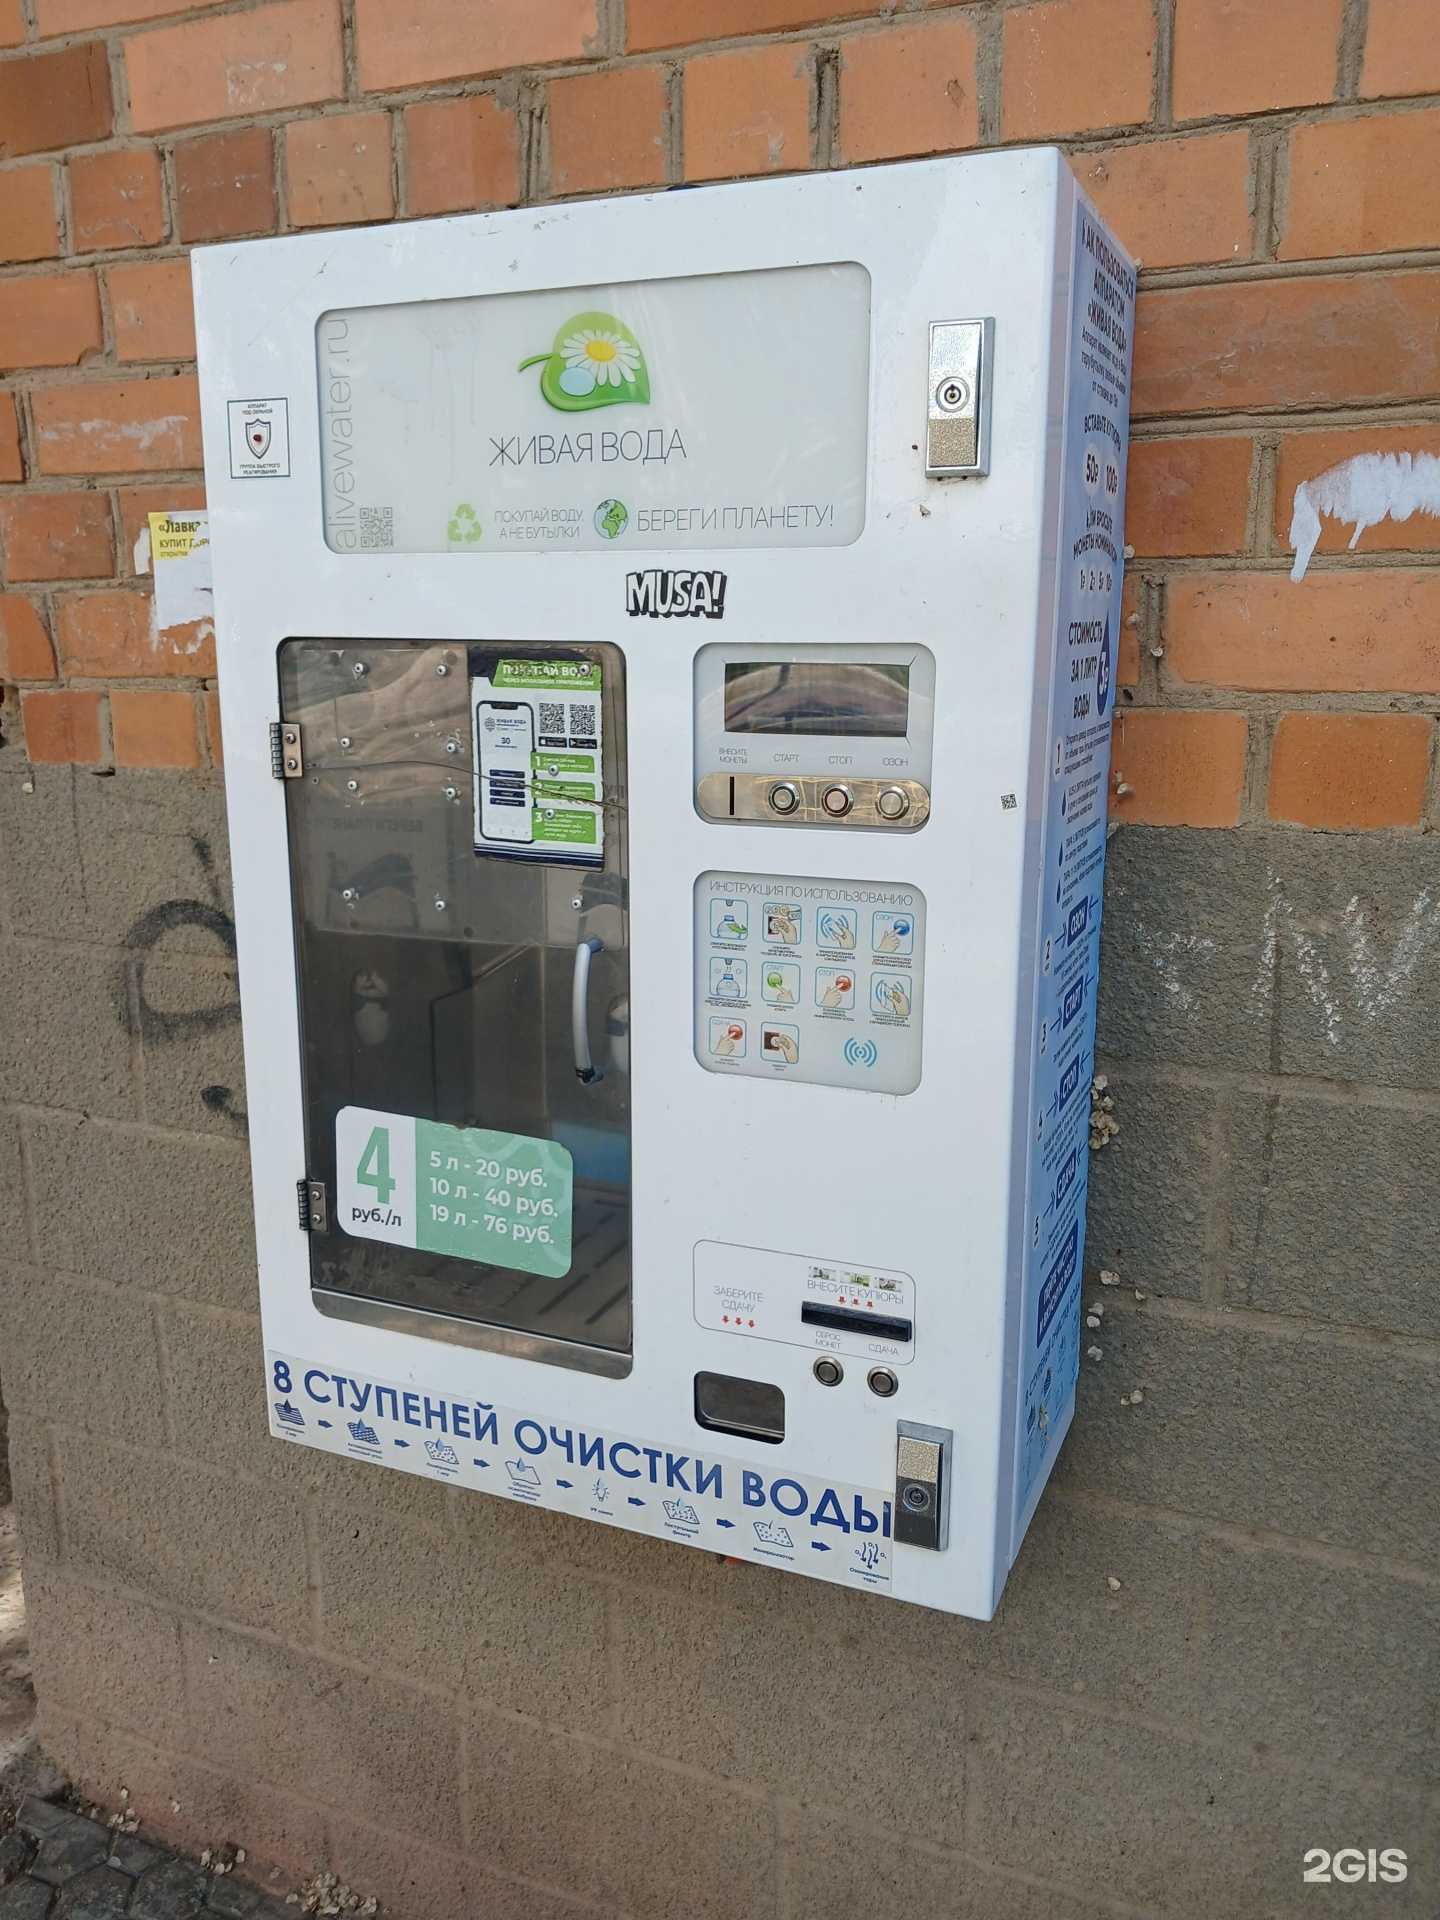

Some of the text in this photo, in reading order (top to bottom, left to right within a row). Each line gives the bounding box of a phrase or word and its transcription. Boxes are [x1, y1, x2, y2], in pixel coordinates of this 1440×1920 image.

[1094, 269, 1125, 321] АППАРАТОМ
[327, 317, 356, 548] alivewater.ru
[489, 429, 687, 467] ЖИВАЯ ВОДА
[495, 507, 549, 523] ПОКУПАЙ
[637, 504, 834, 532] БЕРЕГИ ПЛАНЕТУ!
[160, 539, 187, 548] КУПИТ
[499, 526, 580, 539] А НЕ БУТЫЛКИ
[626, 569, 727, 618] MUSA!
[1068, 620, 1102, 646] СТОИМОСТЬ
[1071, 659, 1079, 683] ЗА
[1073, 692, 1090, 720] ВОДЫ
[535, 756, 541, 767] 1
[773, 753, 799, 763] СТАРТ
[828, 755, 853, 765] СТОП
[883, 757, 908, 767] ОЗОН
[535, 812, 543, 823] 3
[709, 880, 913, 906] ИНСТРУКЦИЯ ПО ИСПОЛЬЗОВАНИЮ
[1071, 905, 1085, 935] ОЗОН
[1065, 984, 1081, 1020] СТАРТ
[1062, 1065, 1077, 1099] СТОП
[356, 1126, 396, 1205] 4
[429, 1151, 441, 1168] 5
[446, 1157, 459, 1170] л
[475, 1158, 500, 1178] 20
[506, 1167, 548, 1188] руб.
[430, 1177, 449, 1196] 10
[454, 1185, 467, 1199] л
[485, 1188, 511, 1207] 40
[516, 1196, 558, 1217] руб.
[352, 1206, 401, 1226] руб./л
[430, 1204, 449, 1222] 19
[454, 1212, 466, 1226] л
[483, 1214, 508, 1234] 76
[512, 1224, 555, 1244] руб.
[713, 1285, 764, 1303] ЗАБЕРИТЕ
[807, 1279, 904, 1305] ВНЕСИТЕ КУПЮРЫ
[721, 1299, 756, 1313] СДАЧУ
[869, 1343, 899, 1355] СДАЧА
[273, 1360, 891, 1538] 8 СТУПЕНЕЙ ОЧИСТКИ ВОДЫ
